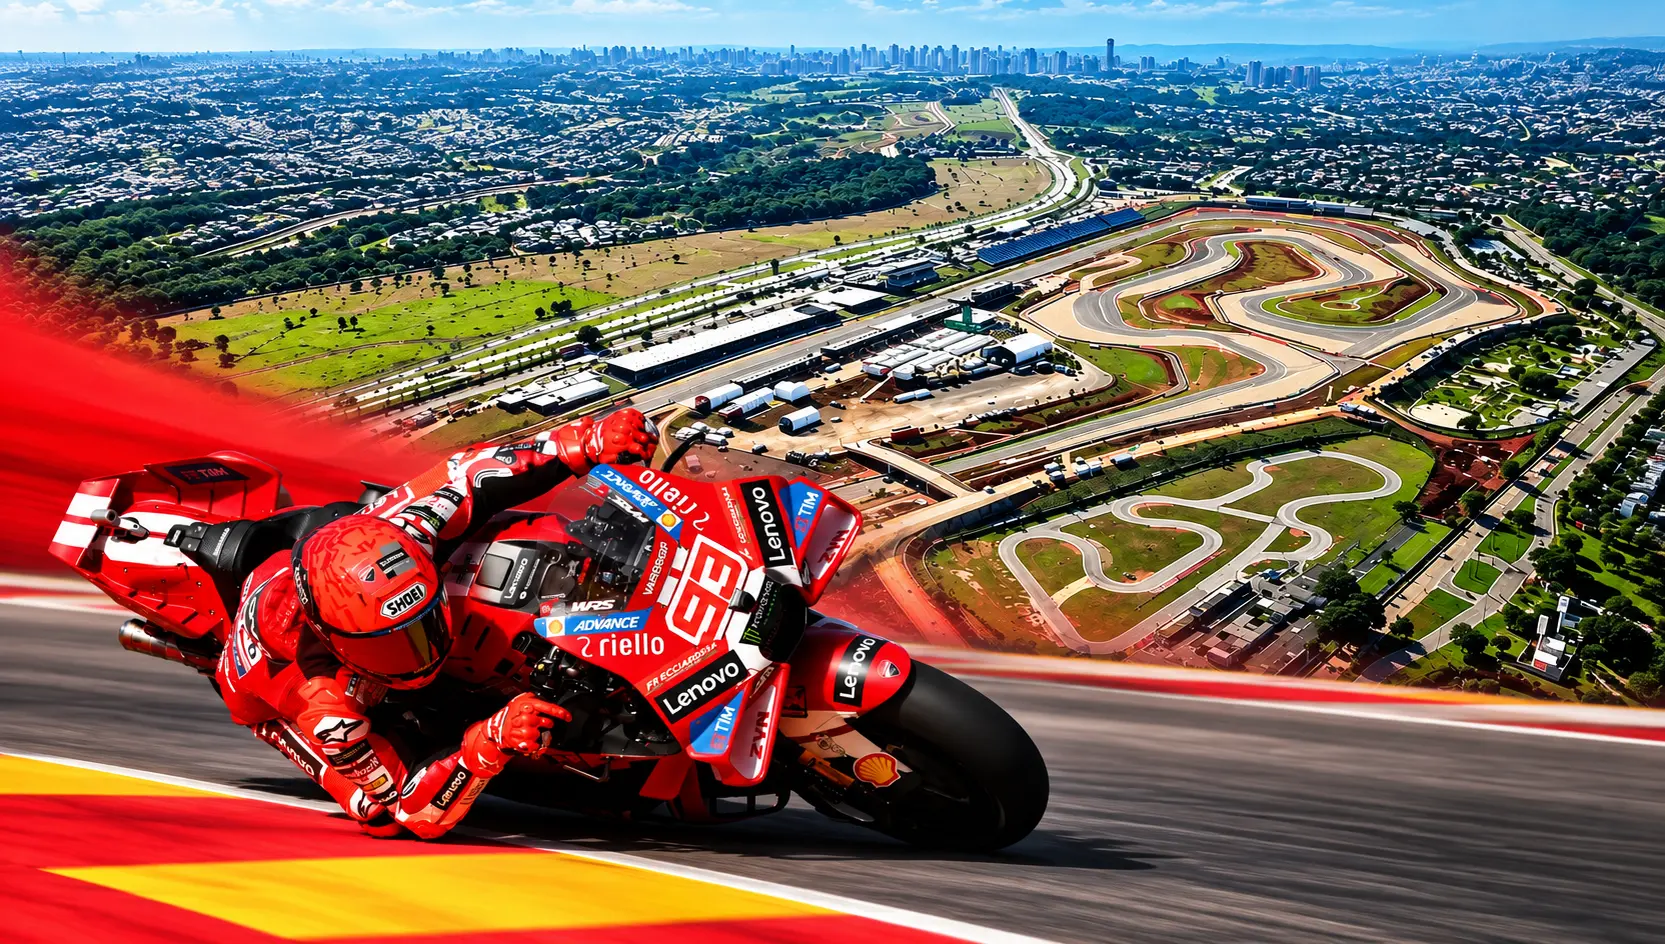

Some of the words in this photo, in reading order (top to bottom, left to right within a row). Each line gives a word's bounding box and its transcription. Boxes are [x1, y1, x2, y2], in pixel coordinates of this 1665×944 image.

[798, 491, 819, 516] TIM
[752, 486, 786, 562] Lenovo
[386, 584, 424, 616] SHOEI
[571, 599, 616, 612] WRS
[573, 616, 640, 632] ADVANCE
[599, 632, 665, 657] riello
[839, 638, 876, 699] Lenovo
[662, 662, 740, 715] Lenovo
[714, 705, 736, 732] TIM
